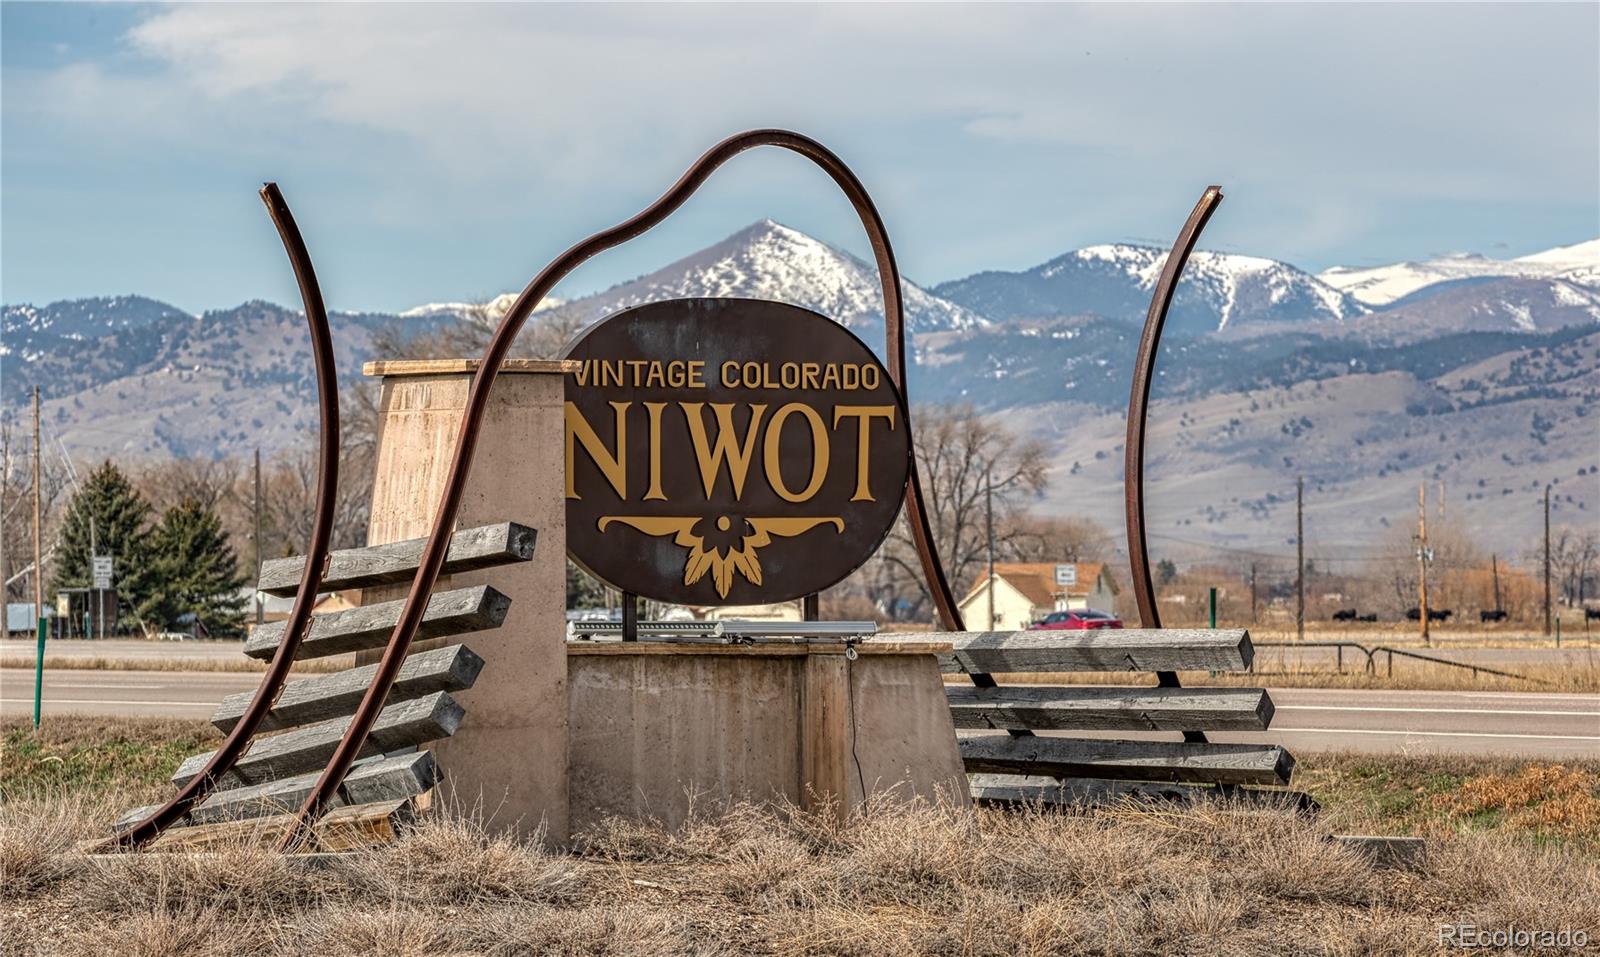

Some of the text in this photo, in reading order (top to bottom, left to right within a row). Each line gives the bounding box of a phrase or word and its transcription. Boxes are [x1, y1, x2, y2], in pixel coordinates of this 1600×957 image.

[574, 360, 880, 390] VINTAGE COLORADO
[565, 401, 896, 503] NIWOT
